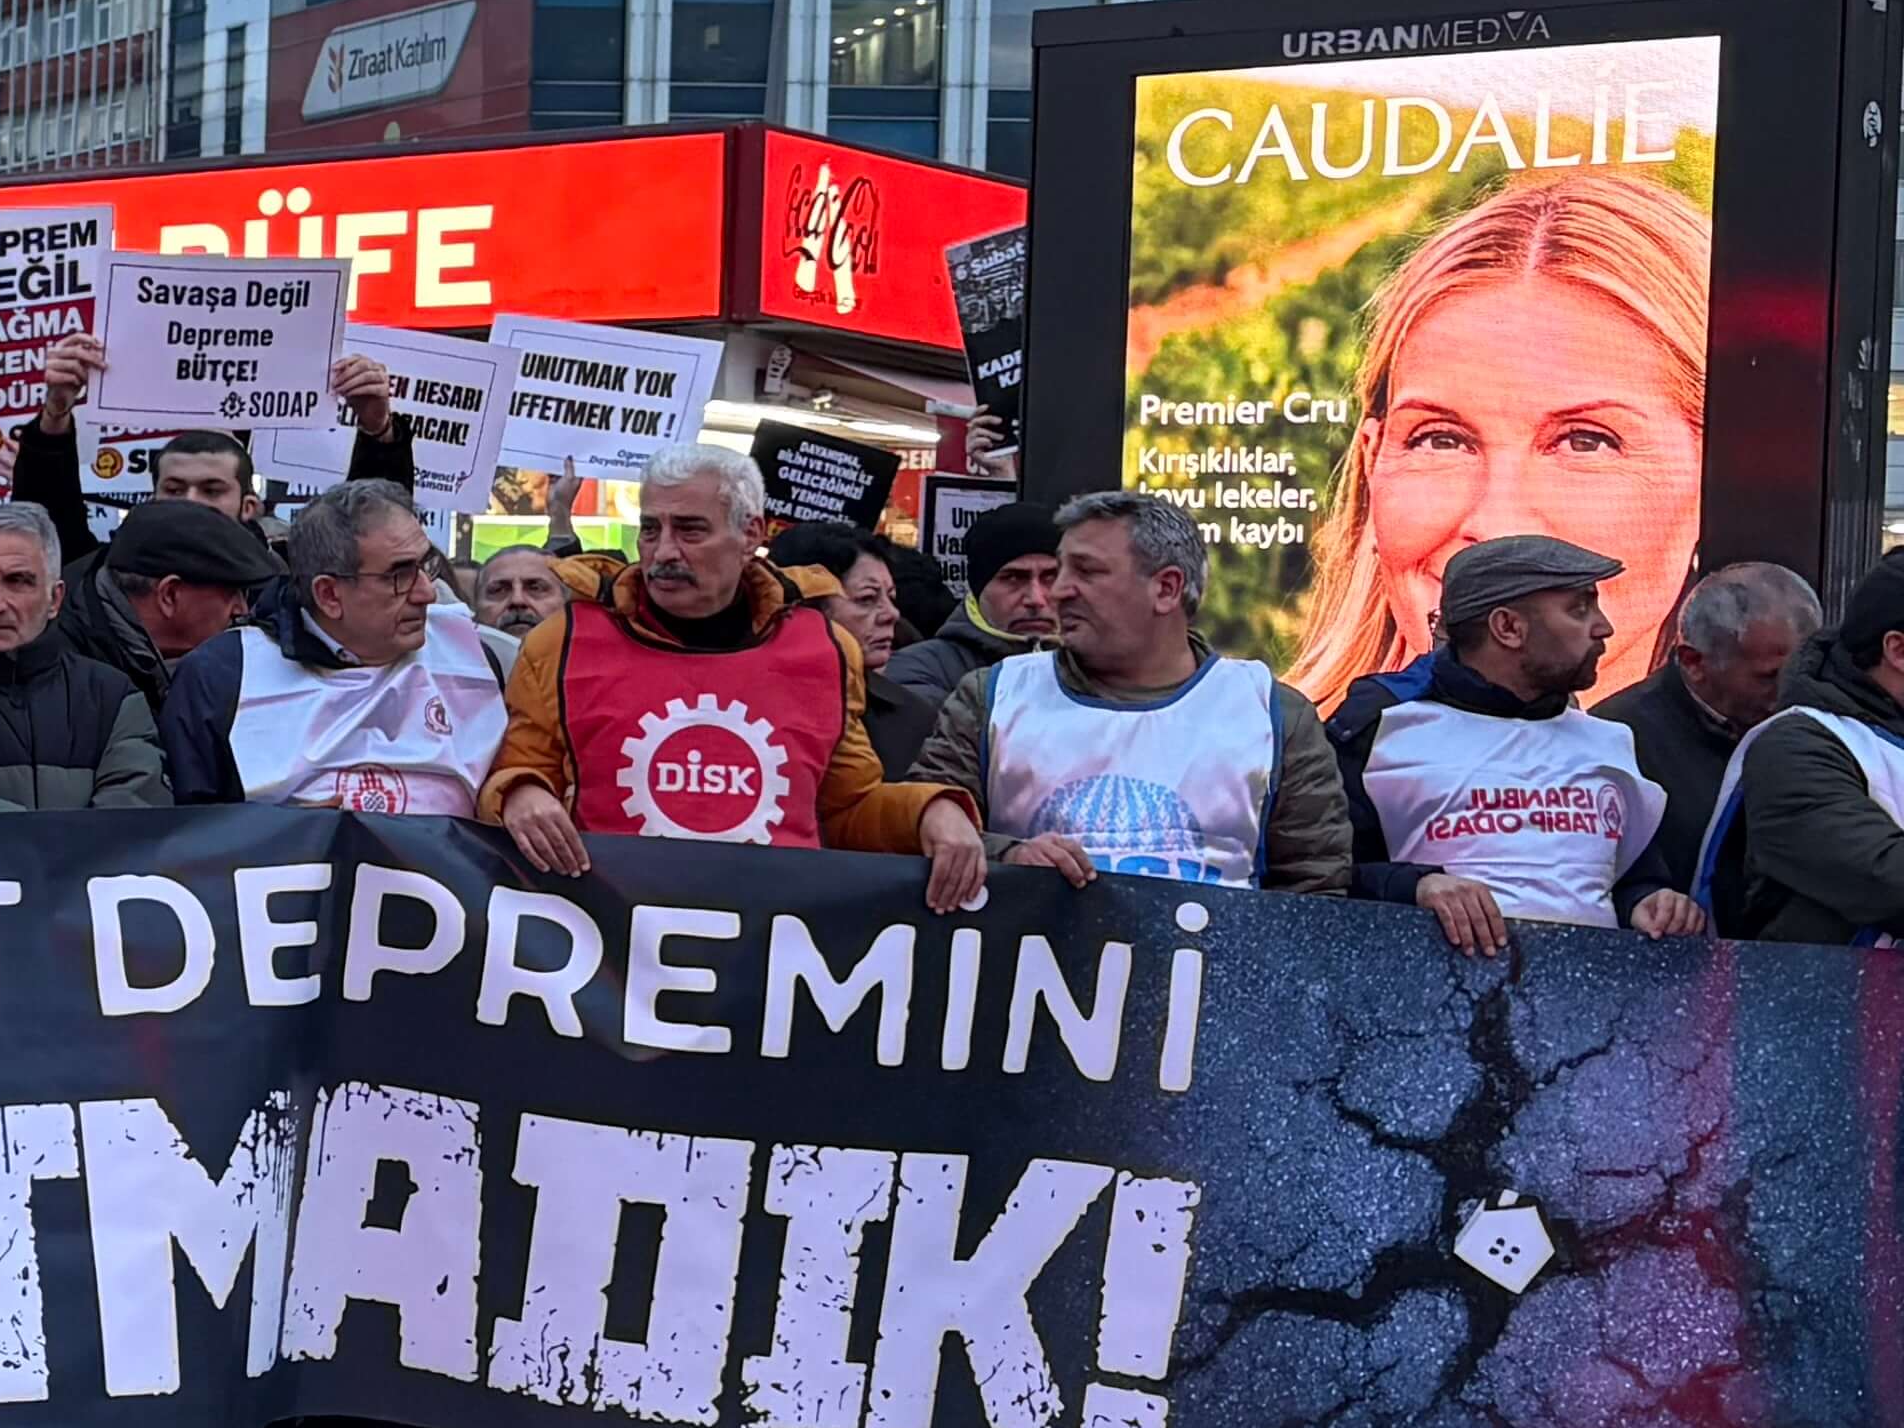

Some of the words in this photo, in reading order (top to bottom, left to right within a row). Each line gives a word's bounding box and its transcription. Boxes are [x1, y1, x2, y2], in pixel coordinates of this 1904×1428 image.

[348, 45, 394, 82] Ziraat
[395, 31, 446, 71] Katılım
[138, 276, 236, 314] Savaşa
[245, 278, 310, 314] Değil
[167, 321, 274, 353] Depreme
[176, 355, 258, 387] BÜTÇE!
[521, 351, 630, 393] UNUTMAK
[634, 367, 677, 399] YOK
[248, 390, 318, 419] SODAP
[413, 379, 483, 413] HESABI
[1140, 393, 1274, 425] Premier
[1283, 392, 1348, 424] Cru
[618, 406, 659, 435] YOK
[1139, 446, 1296, 479] Kırışıklıklar,
[791, 486, 845, 513] YENİDEN
[1215, 480, 1318, 512] lekeler,
[1230, 515, 1304, 550] kaybı
[655, 749, 756, 798] DİSK
[86, 862, 1209, 1094] DEPREMİNİ
